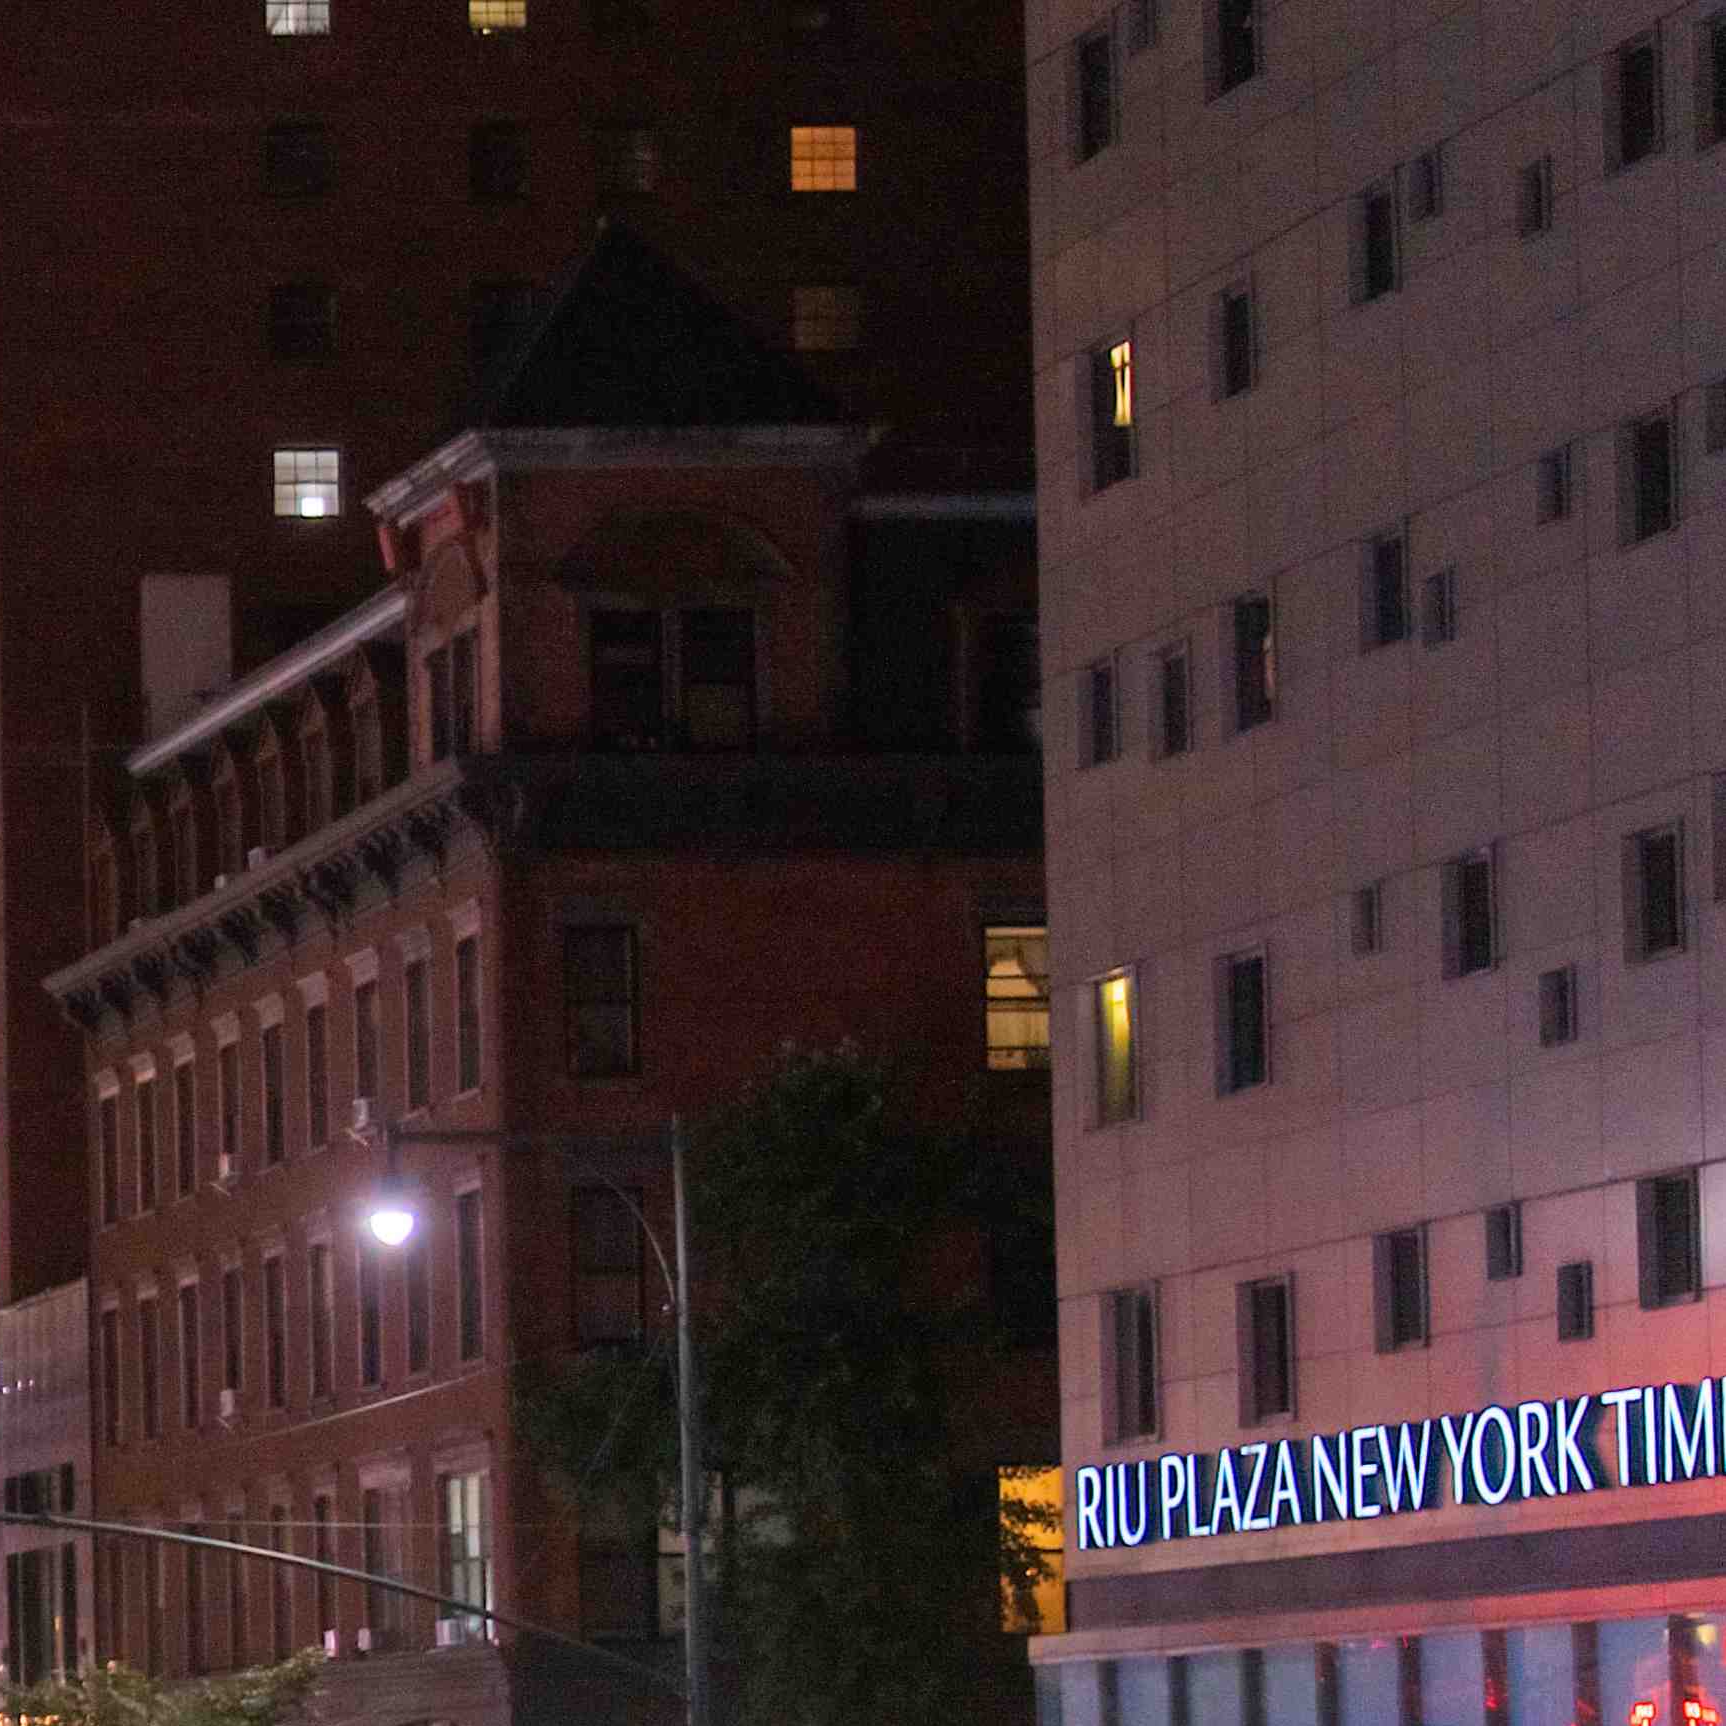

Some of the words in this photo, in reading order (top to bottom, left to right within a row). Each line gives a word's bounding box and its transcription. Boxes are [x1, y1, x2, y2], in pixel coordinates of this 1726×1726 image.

[1077, 1461, 1147, 1550] RIU
[1159, 1439, 1302, 1542] PLAZA
[1312, 1422, 1432, 1521] NEW
[1442, 1397, 1596, 1506] YORK
